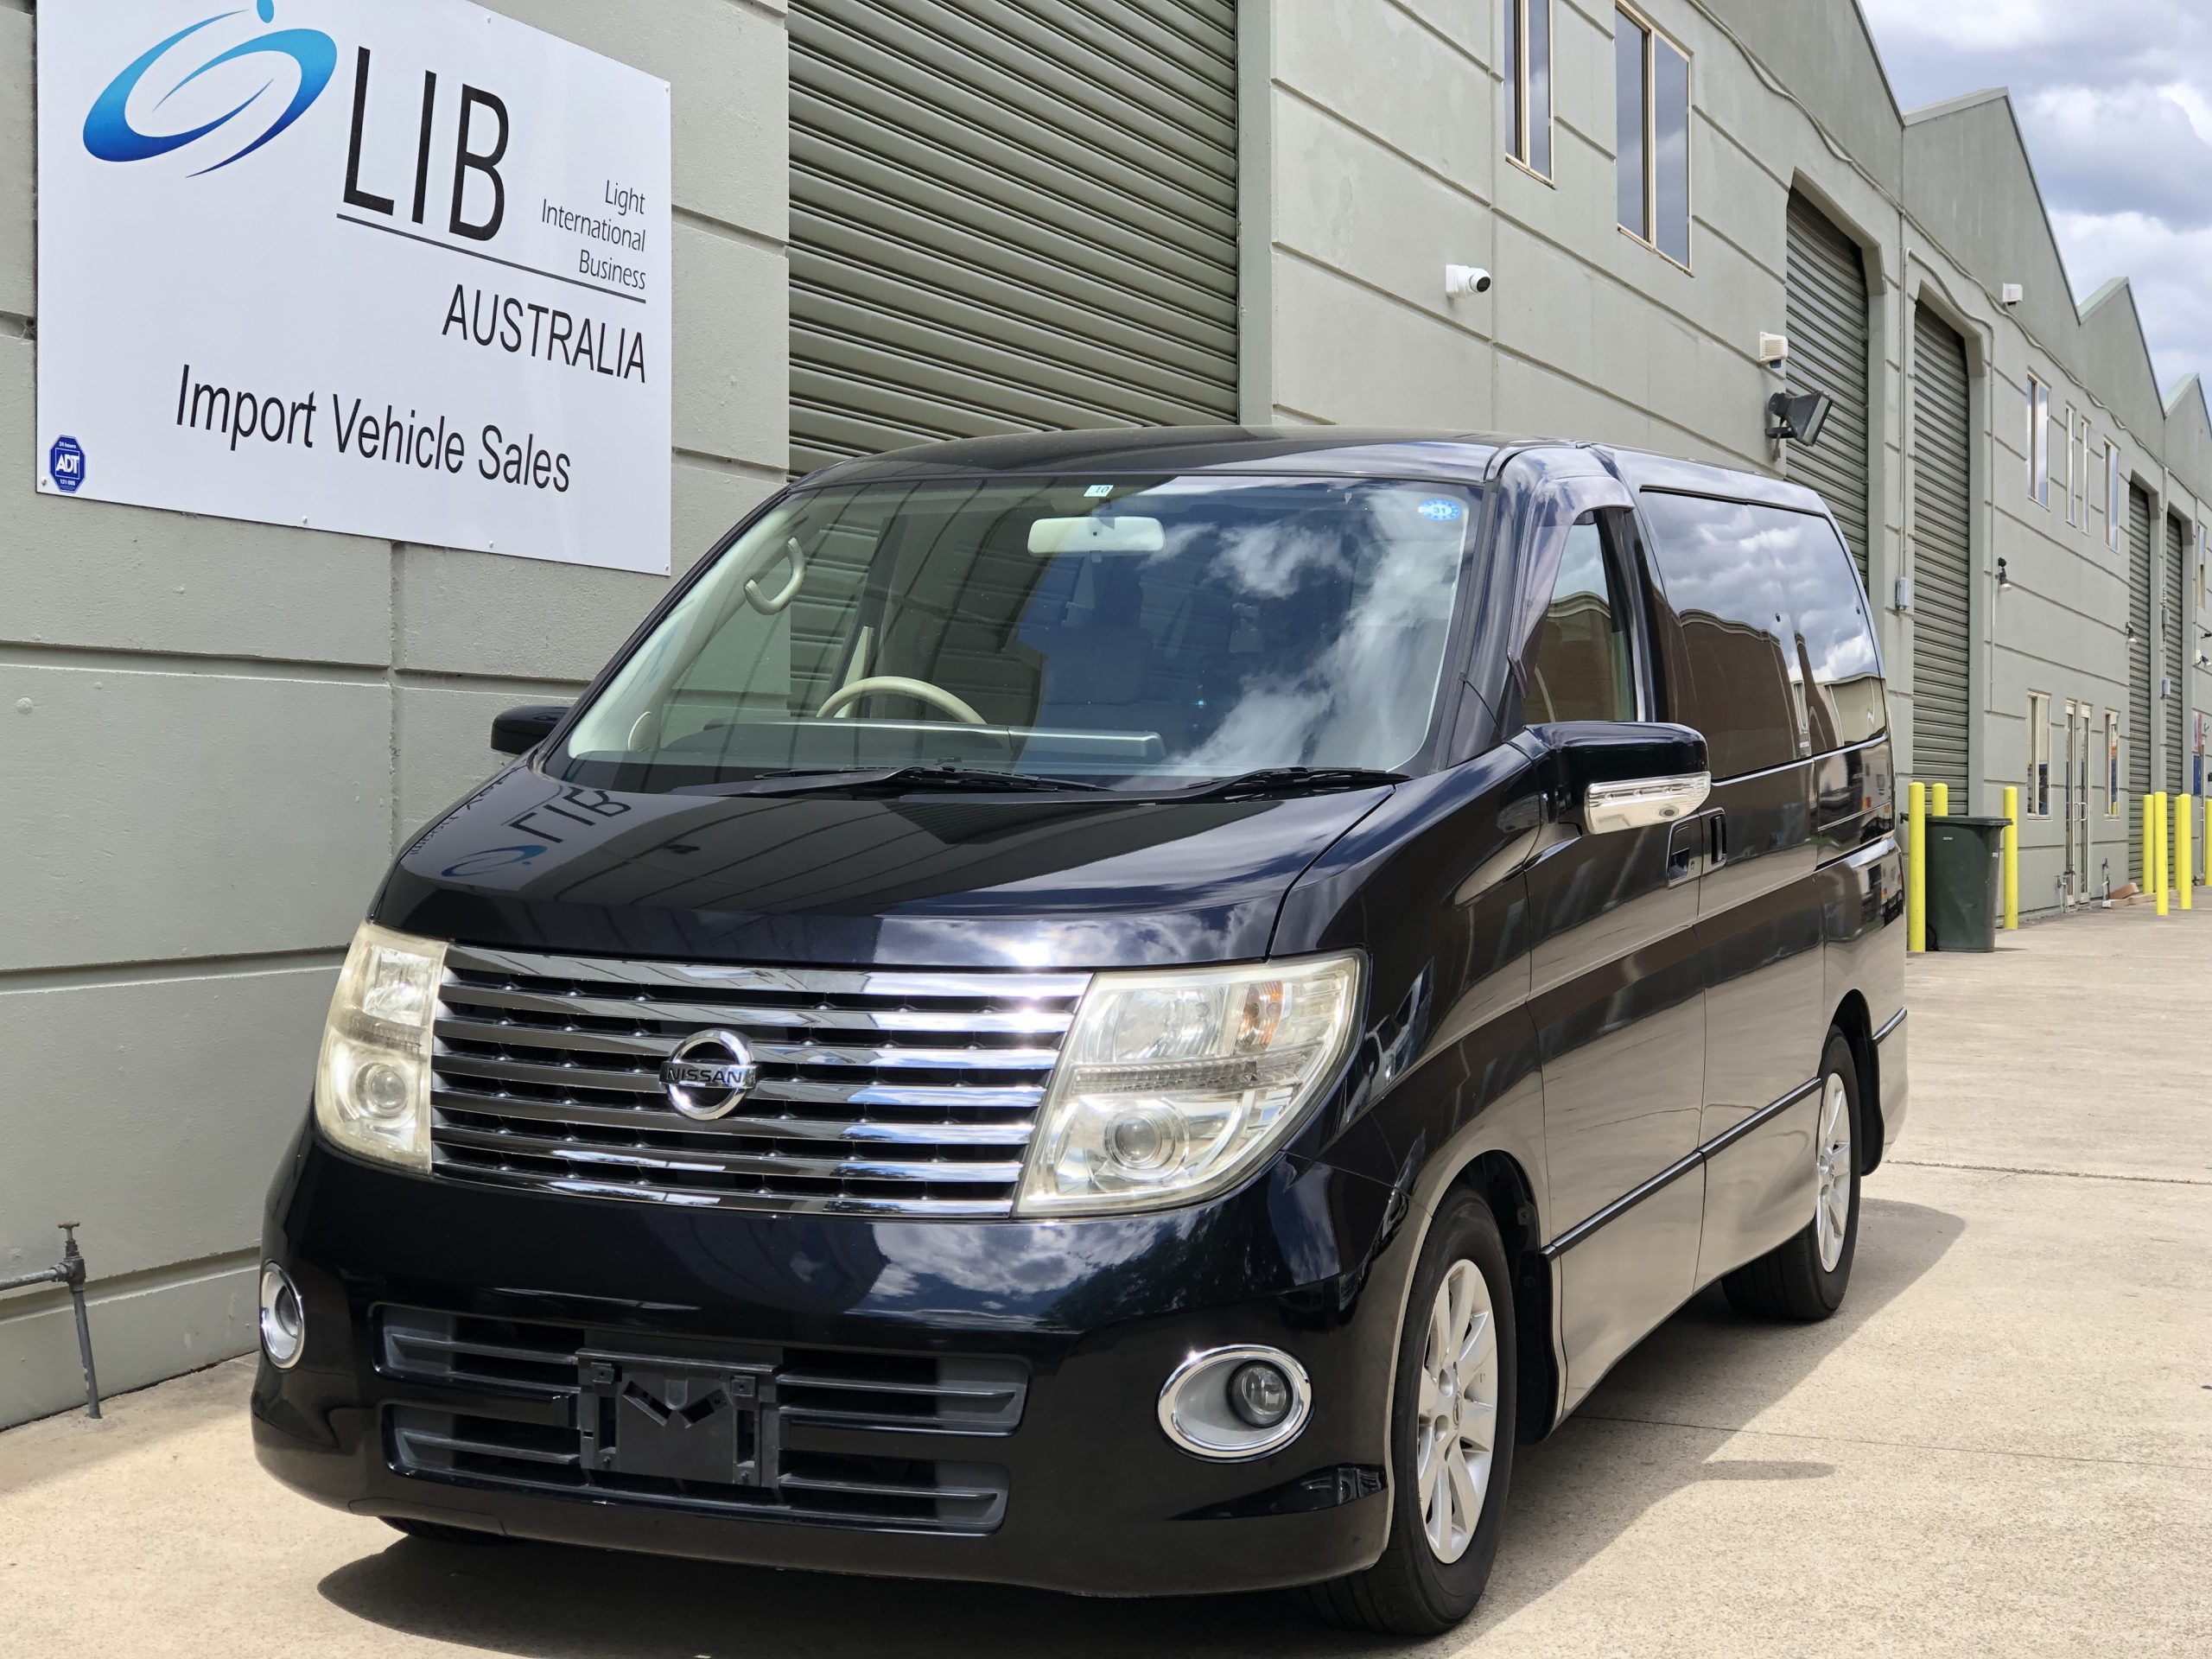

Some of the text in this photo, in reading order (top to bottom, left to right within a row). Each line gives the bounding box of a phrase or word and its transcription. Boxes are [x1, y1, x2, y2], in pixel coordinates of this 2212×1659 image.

[342, 46, 509, 242] LIB
[605, 179, 645, 216] Light
[542, 199, 645, 252] International
[579, 249, 646, 290] Business
[442, 283, 646, 384] AUSTRALIA
[176, 364, 571, 493] Import Vehicle Sales
[56, 454, 79, 474] ADT
[667, 1067, 743, 1084] NISSAN
